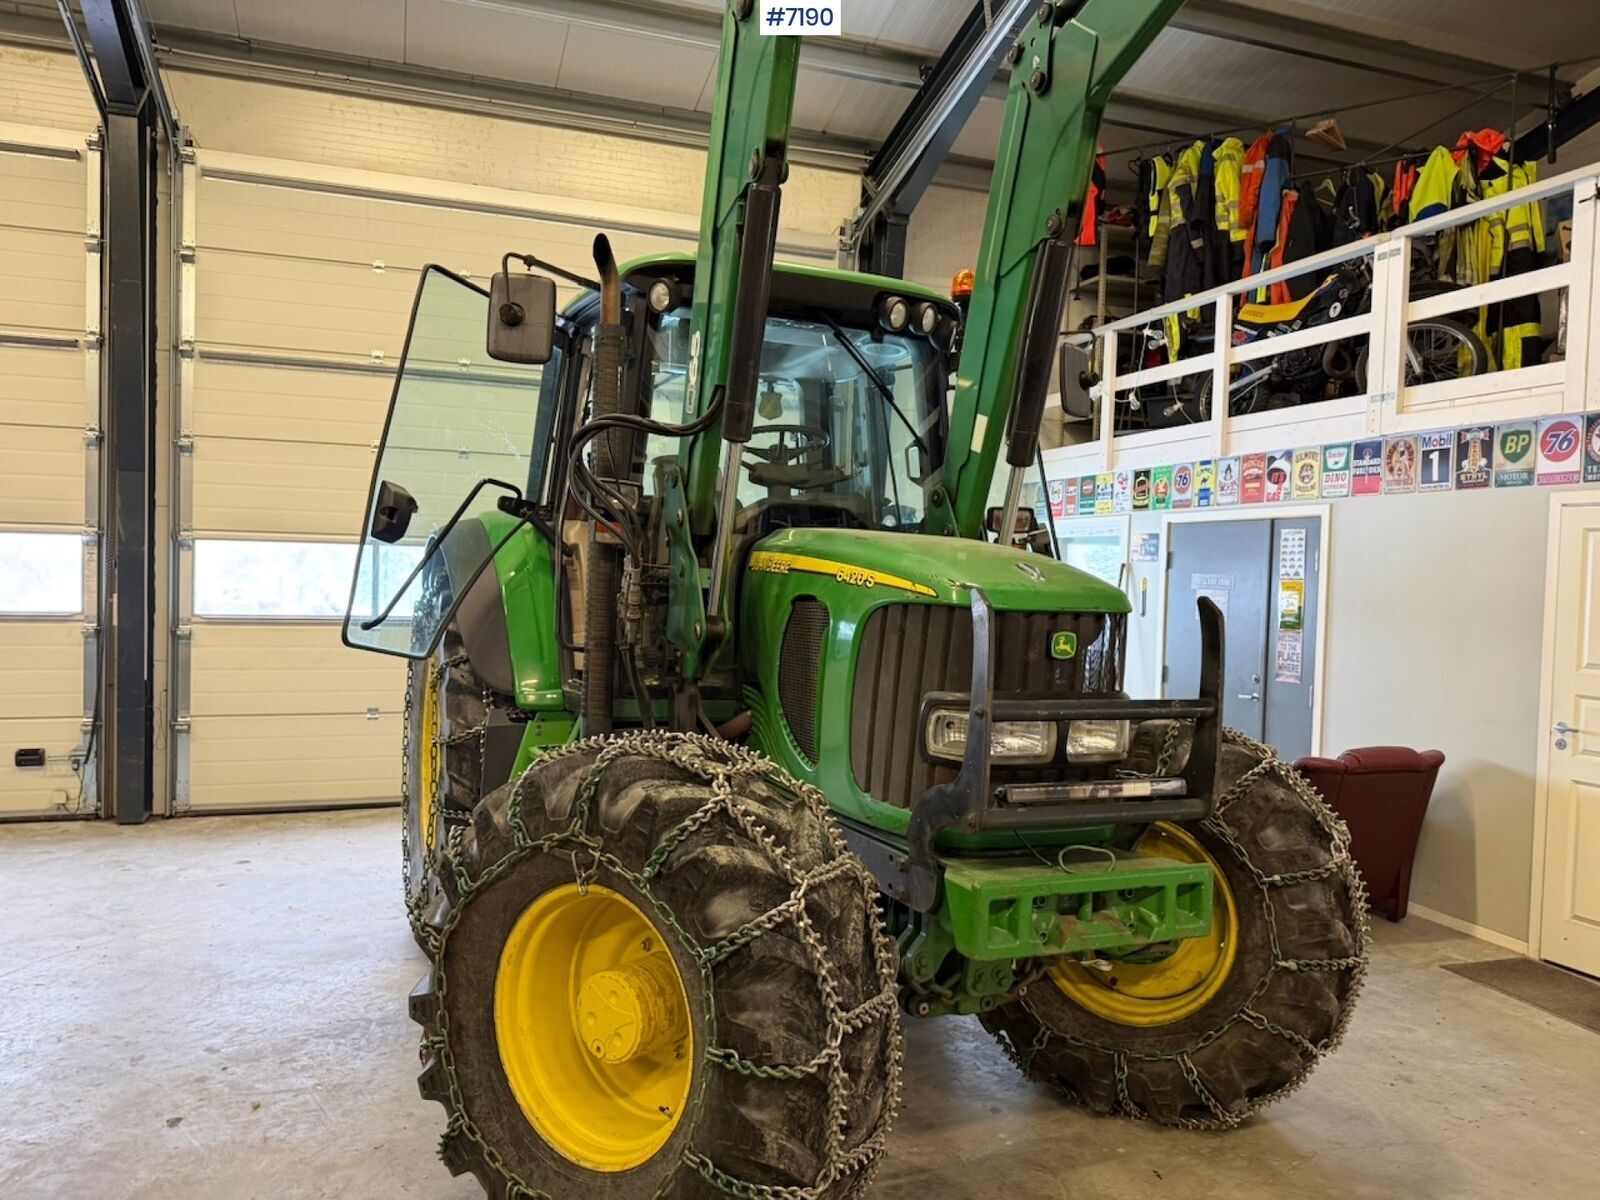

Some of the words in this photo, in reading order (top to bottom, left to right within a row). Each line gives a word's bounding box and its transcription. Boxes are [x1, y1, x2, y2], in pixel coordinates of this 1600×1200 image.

[1422, 434, 1452, 448] Mobil
[1504, 434, 1529, 454] BP
[1544, 428, 1576, 454] 76
[1429, 450, 1440, 481] 1
[1176, 471, 1190, 488] 76
[1324, 472, 1347, 483] DINO
[766, 560, 790, 573] DEERE
[1278, 651, 1301, 662] PLACE
[1277, 662, 1301, 673] WHERE
